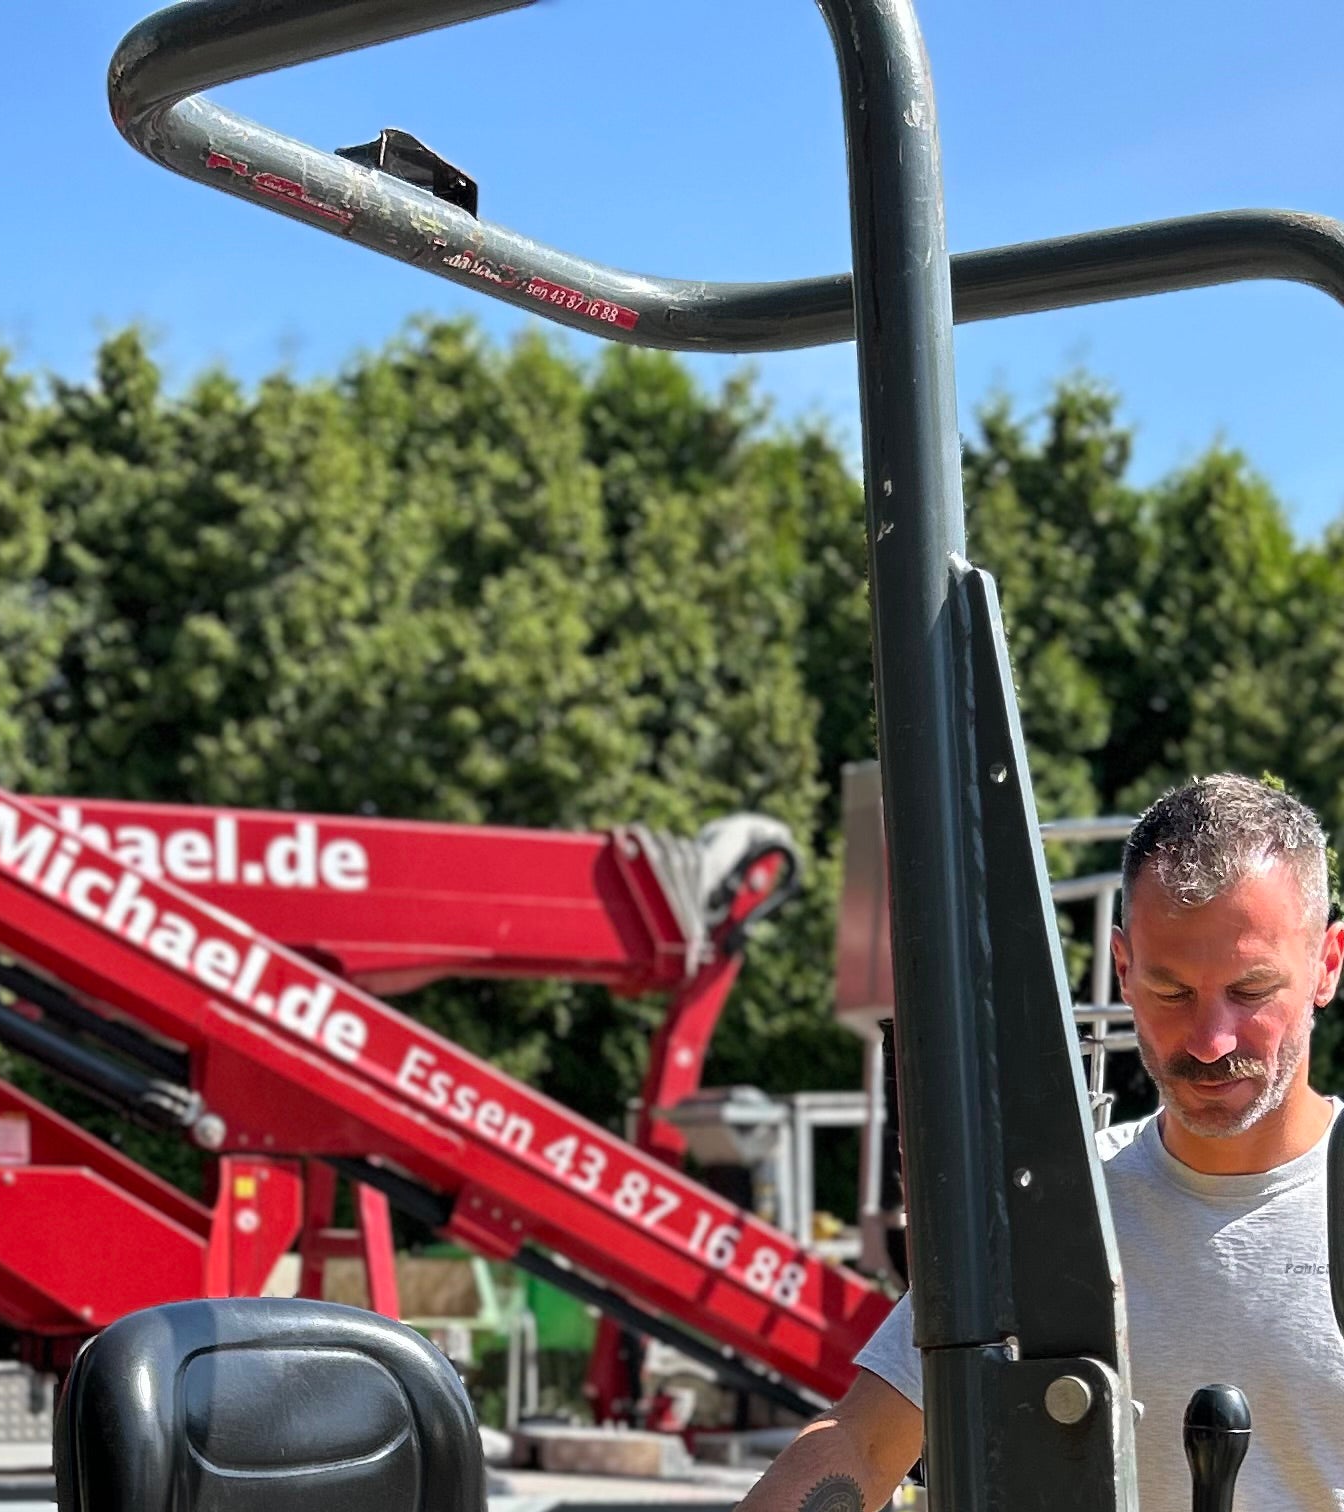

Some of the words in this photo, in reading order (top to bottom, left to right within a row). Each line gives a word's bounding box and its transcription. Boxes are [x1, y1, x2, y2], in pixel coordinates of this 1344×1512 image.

[549, 288, 566, 306] 43
[566, 293, 584, 310] 87
[585, 298, 599, 316] 16
[600, 306, 618, 322] 88
[395, 1047, 534, 1153] Essen
[544, 1136, 607, 1194] 43
[613, 1172, 681, 1228] 87
[688, 1211, 743, 1270] 16
[745, 1248, 808, 1308] 88
